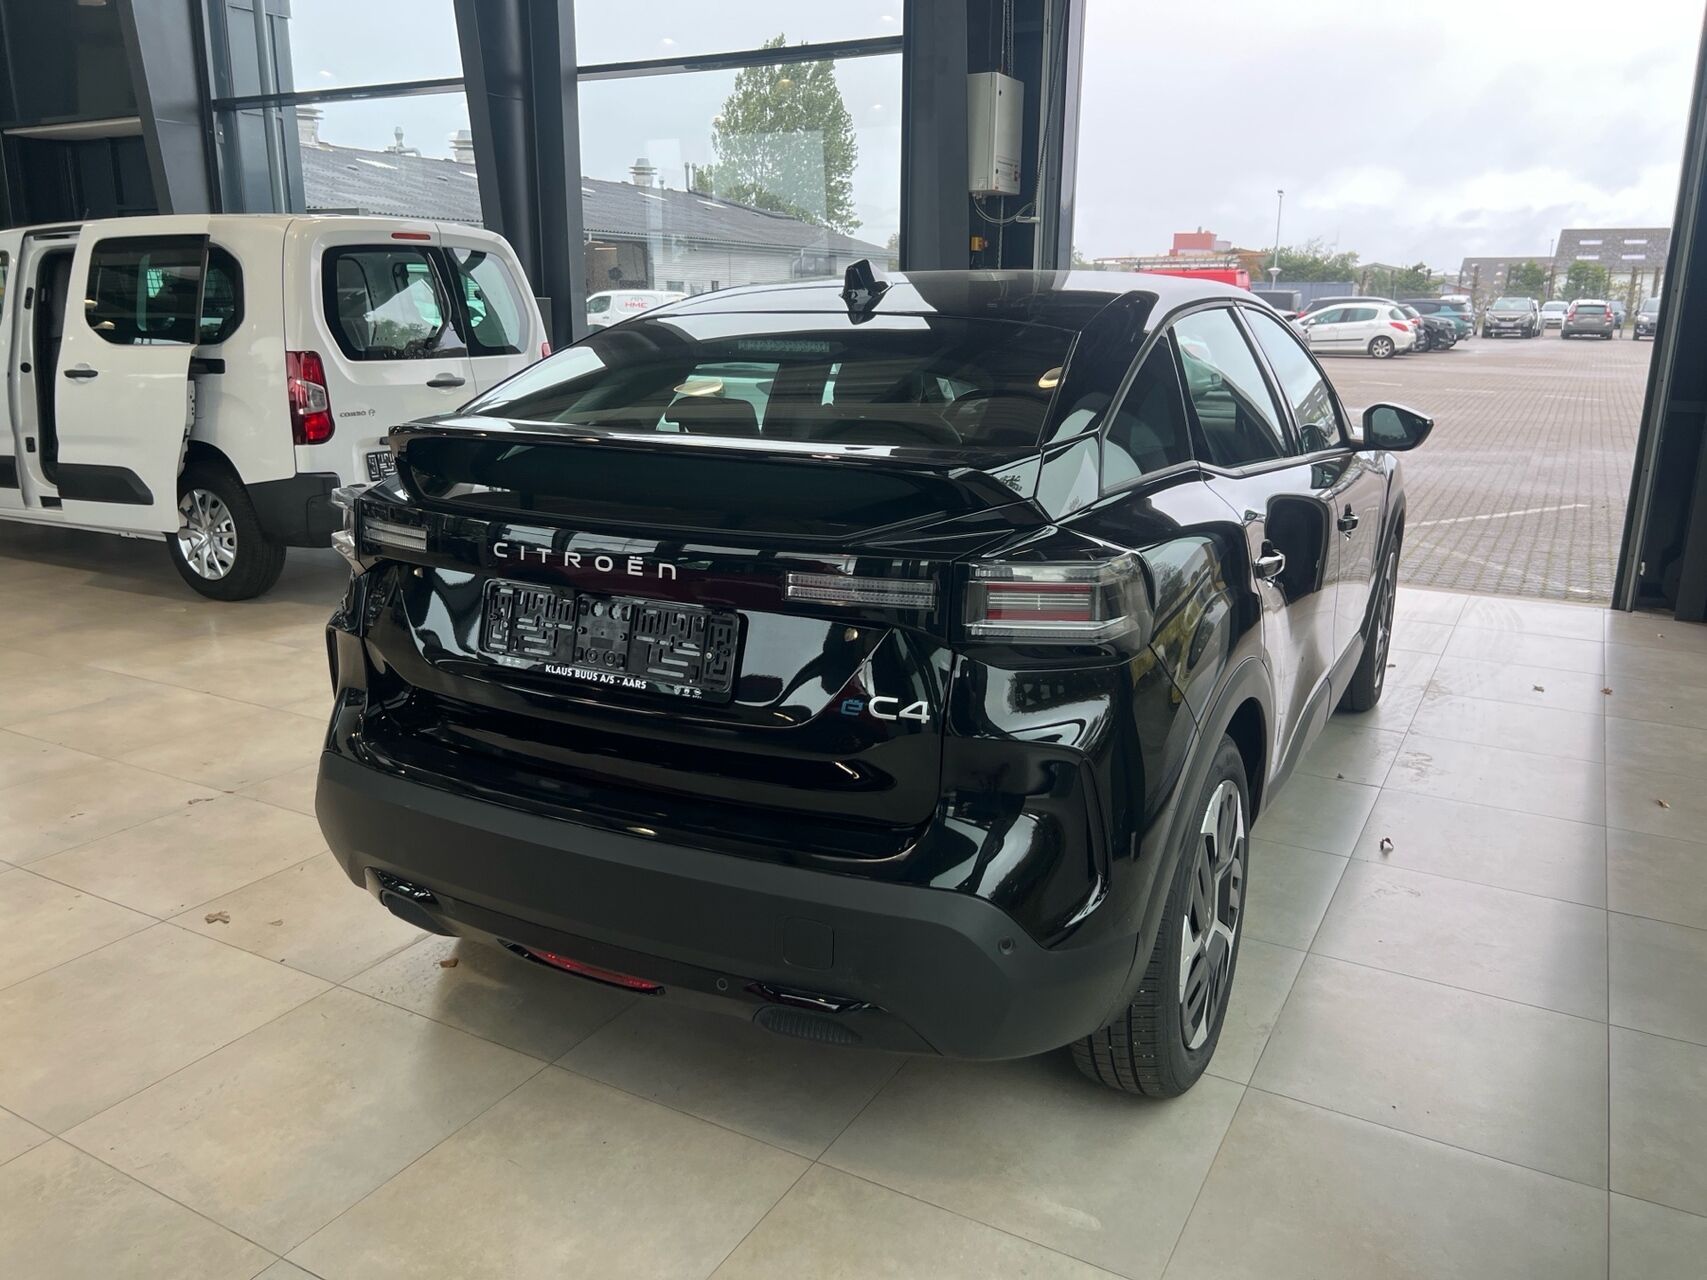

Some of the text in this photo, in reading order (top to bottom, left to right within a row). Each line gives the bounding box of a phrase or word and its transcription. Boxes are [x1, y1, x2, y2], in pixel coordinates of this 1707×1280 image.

[545, 664, 573, 677] KLAUS
[574, 669, 598, 682] BUUS
[599, 674, 615, 684] A/S
[622, 678, 647, 690] AARS
